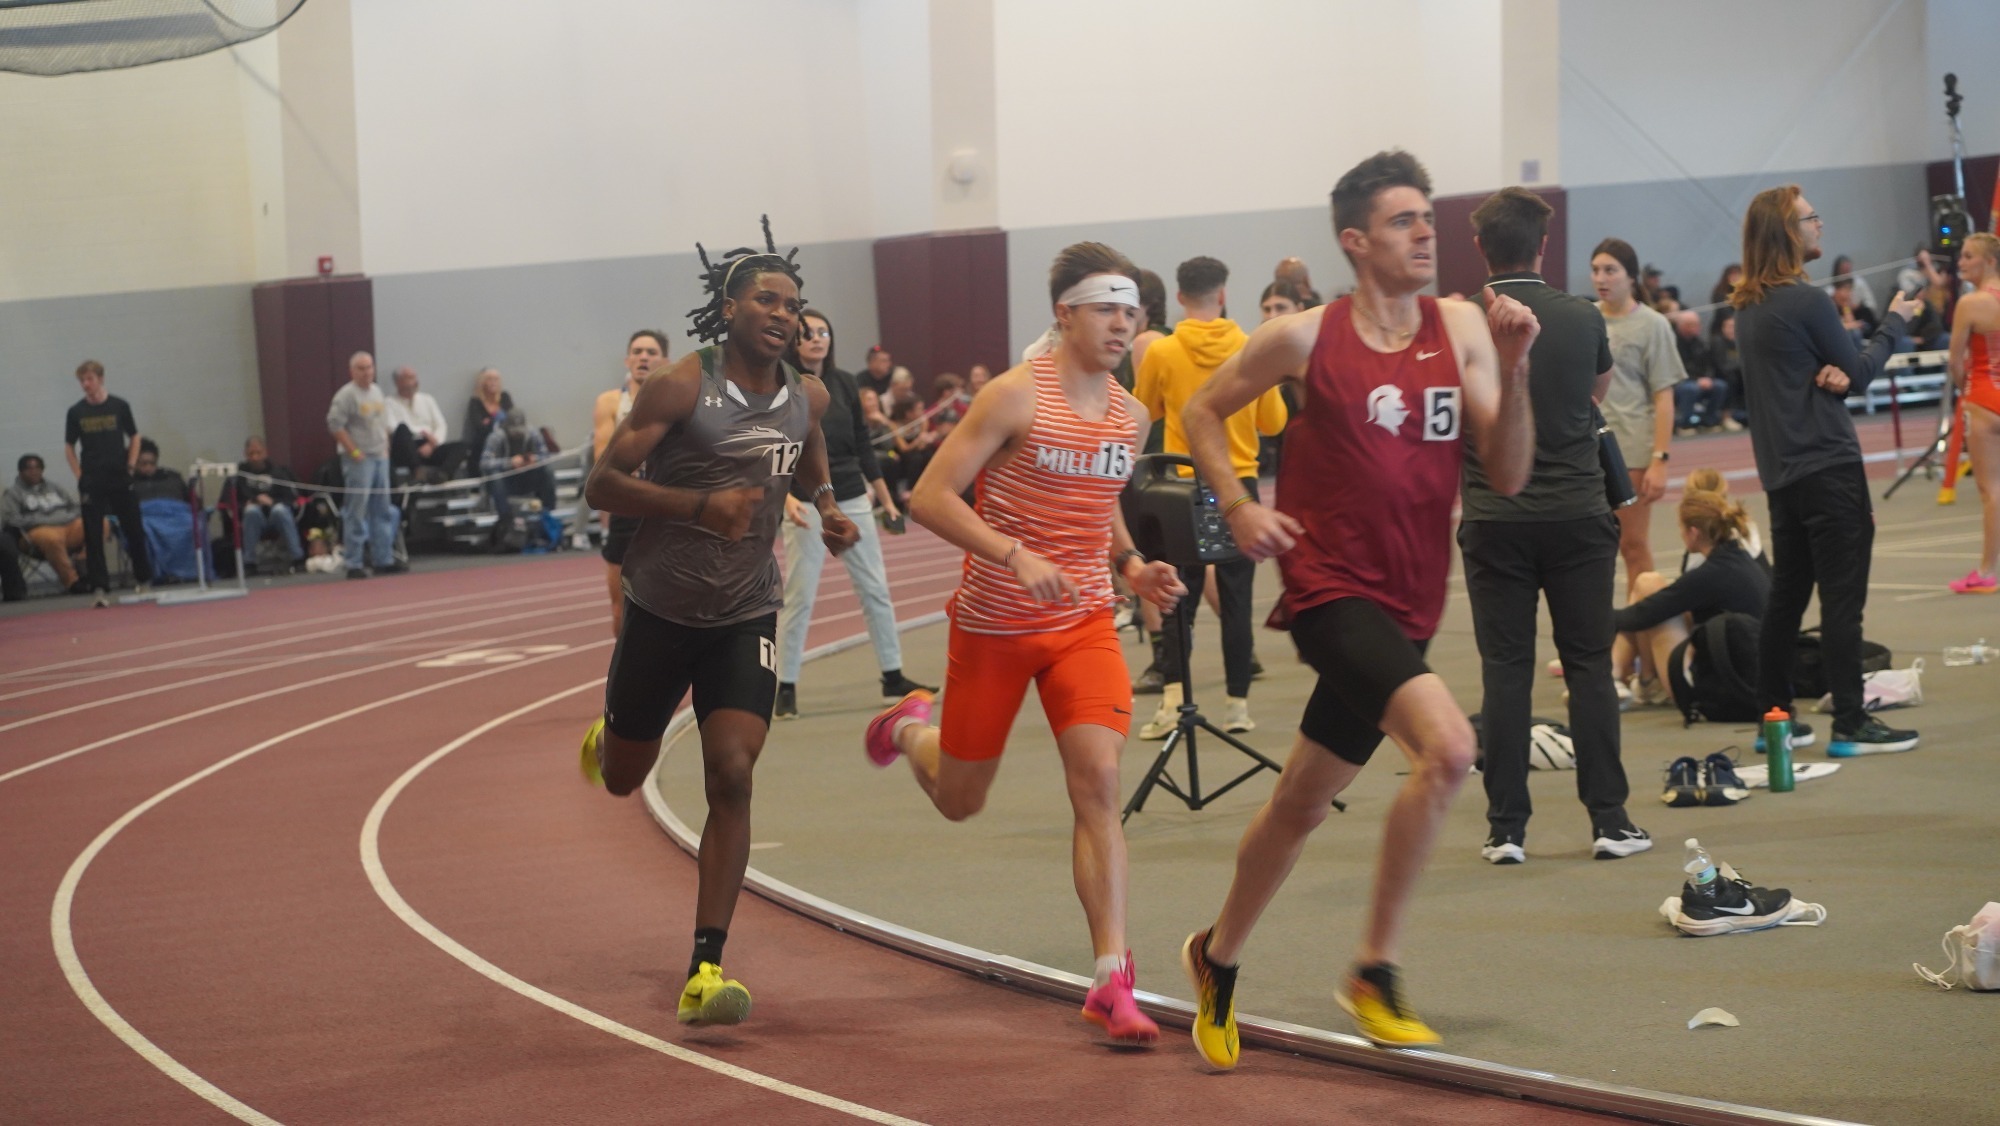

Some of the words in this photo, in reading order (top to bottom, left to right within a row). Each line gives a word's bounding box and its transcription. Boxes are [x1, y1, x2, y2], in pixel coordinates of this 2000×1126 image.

[1432, 391, 1453, 437] 5
[775, 444, 799, 474] 12
[1103, 443, 1126, 475] 15
[762, 641, 777, 673] 1
